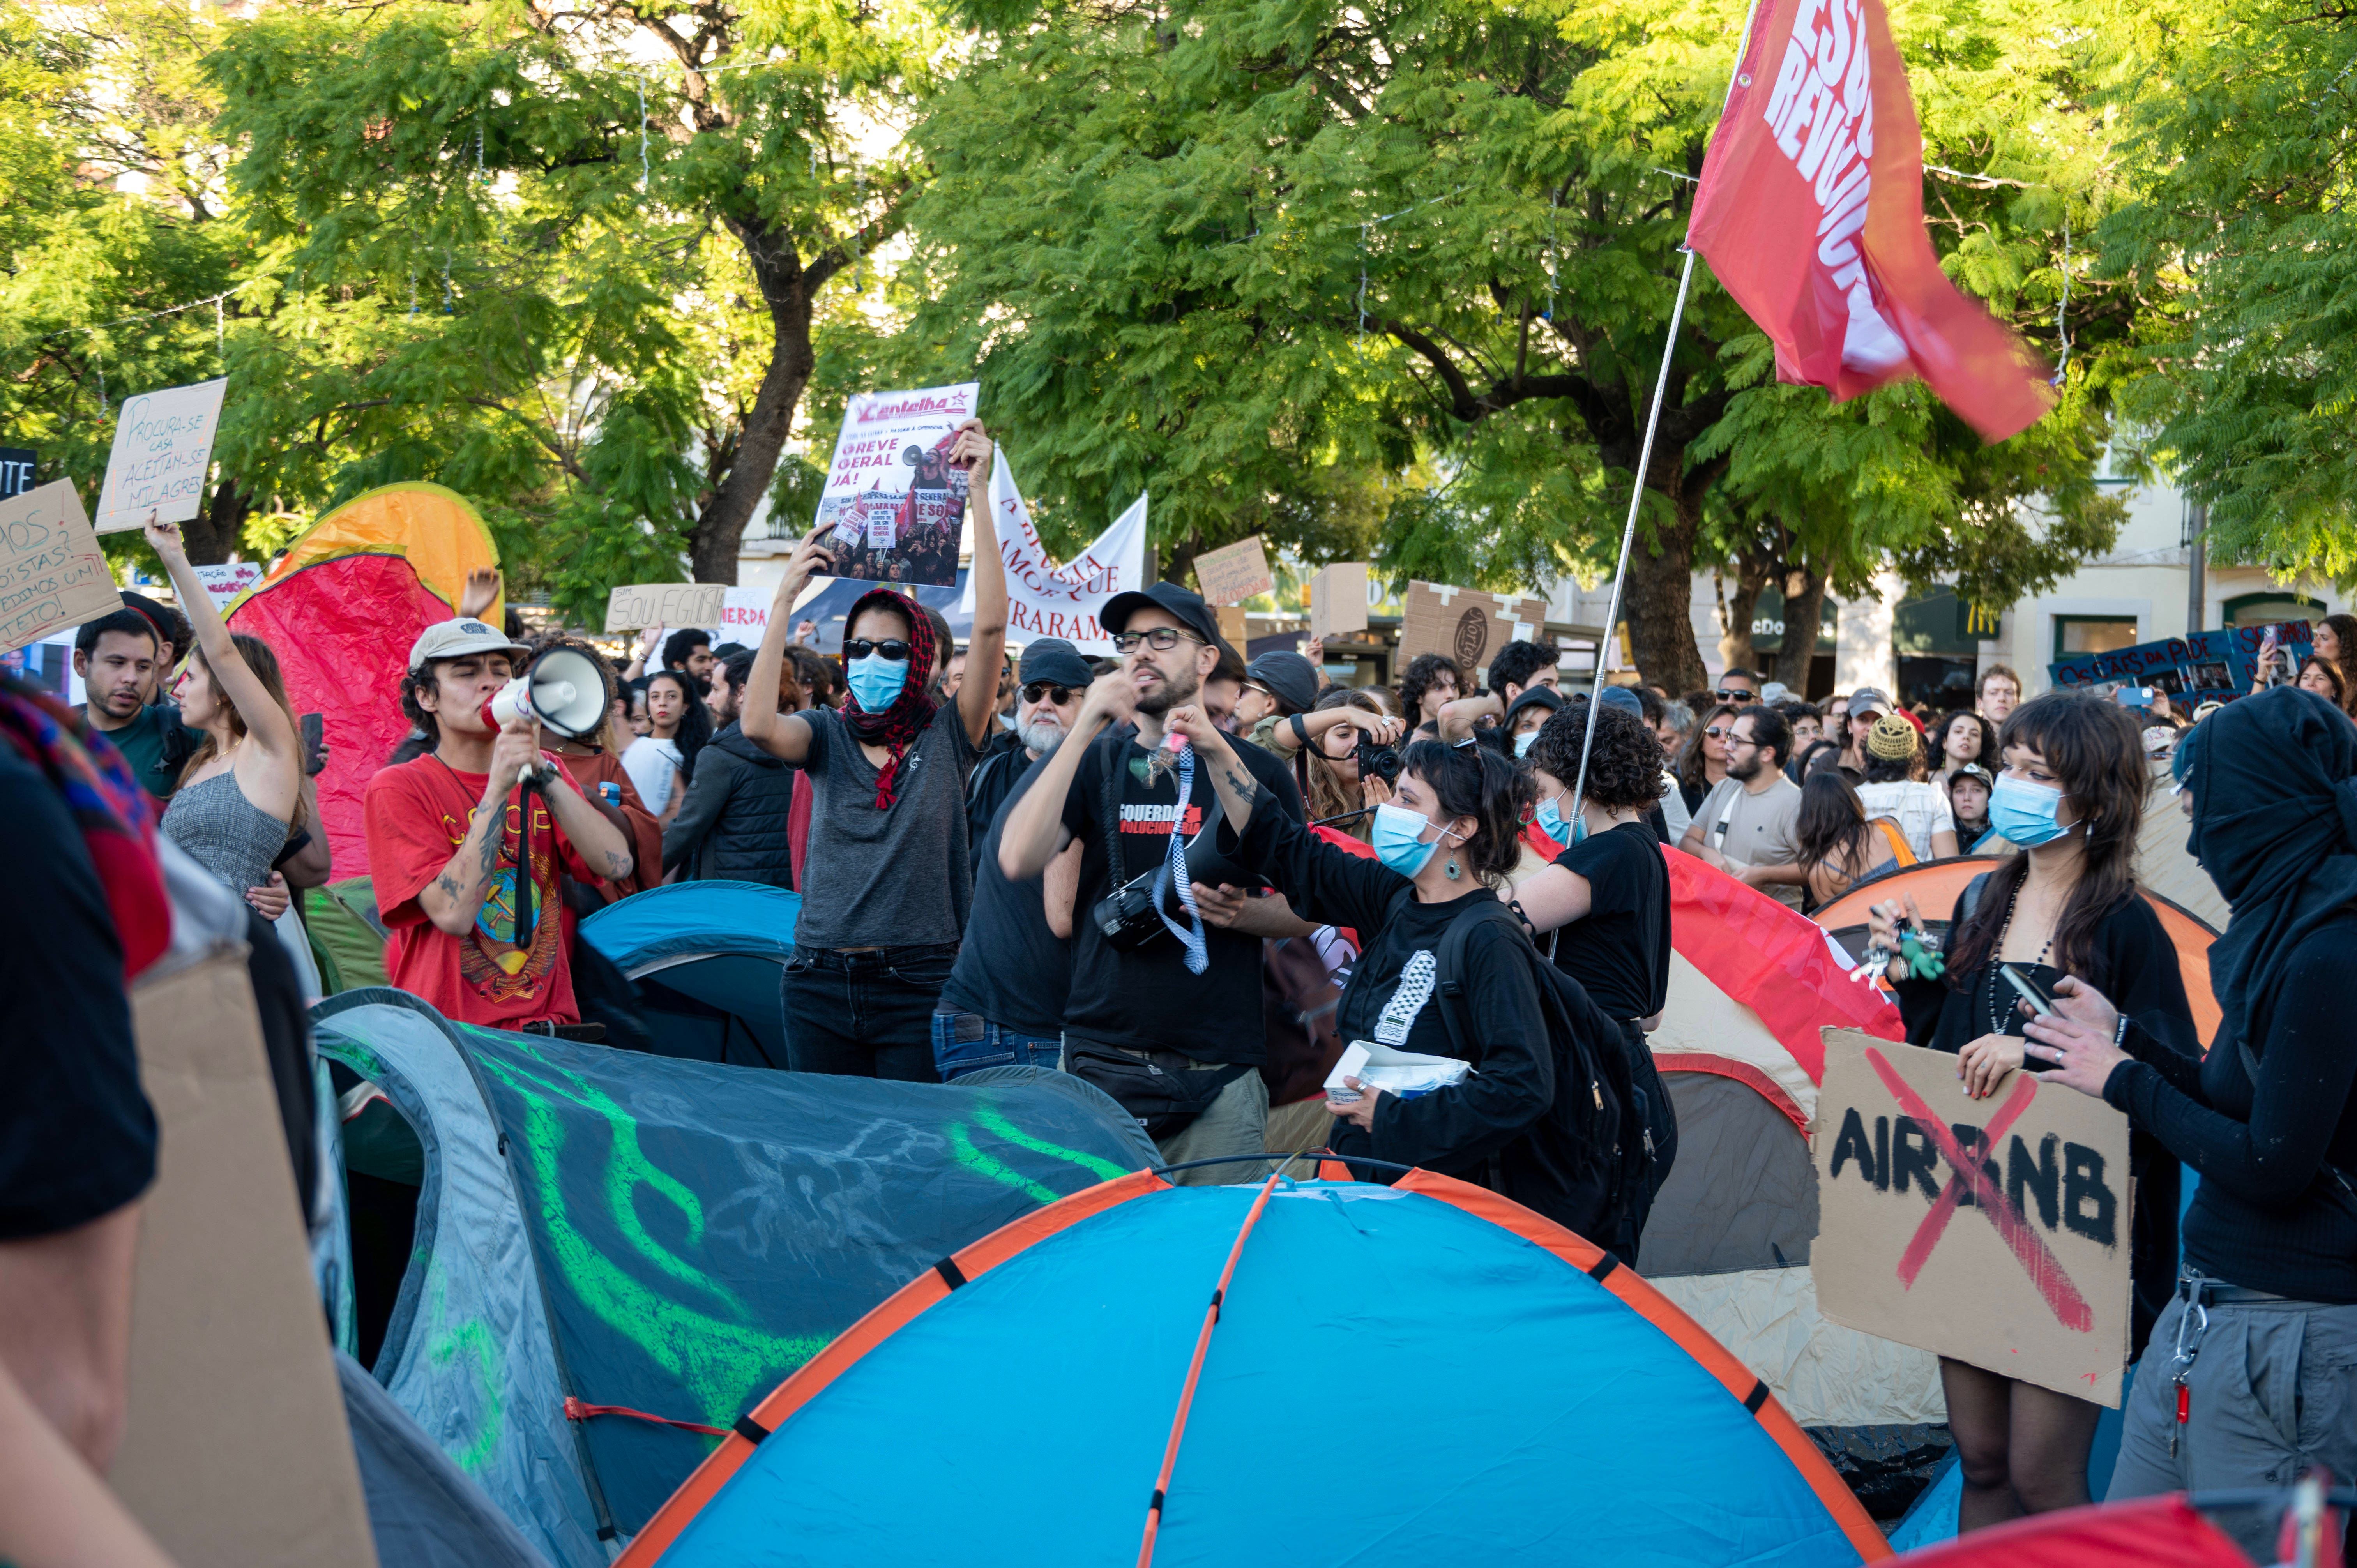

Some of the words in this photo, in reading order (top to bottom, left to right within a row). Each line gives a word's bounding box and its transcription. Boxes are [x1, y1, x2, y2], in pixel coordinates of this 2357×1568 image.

[127, 397, 203, 448] PROCURA-SE
[857, 397, 947, 424] Centelha
[149, 438, 173, 452] CASA
[842, 438, 899, 456] GREVE
[838, 454, 893, 470] GERAL
[832, 469, 859, 487] JÁ!
[128, 476, 201, 512] MILAGRES
[610, 597, 655, 625] SOU
[1458, 608, 1484, 668] Nortejo
[2167, 637, 2211, 664] PIDE
[1120, 820, 1201, 835] VOLUCIONRIA
[1830, 1107, 2118, 1249] AIRBNB
